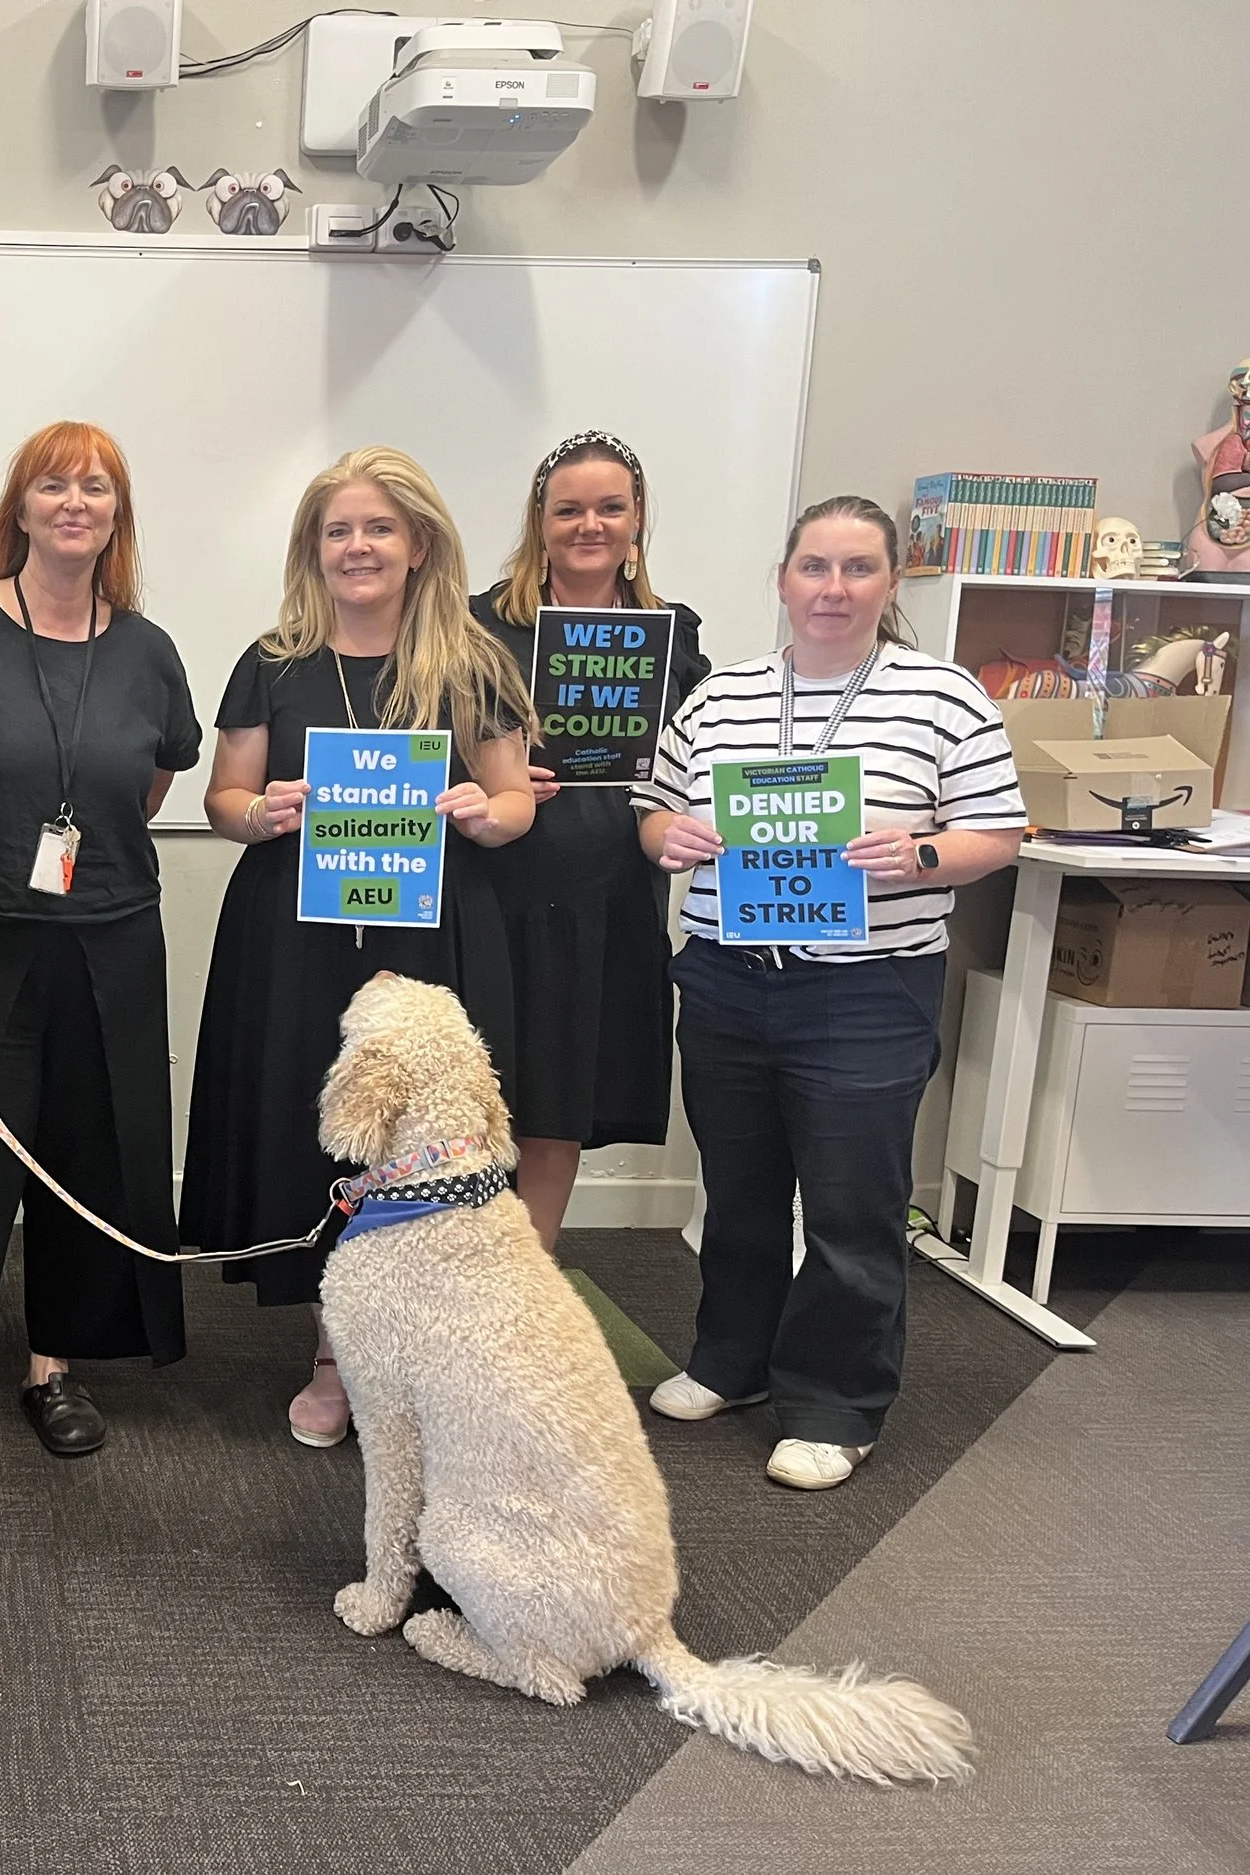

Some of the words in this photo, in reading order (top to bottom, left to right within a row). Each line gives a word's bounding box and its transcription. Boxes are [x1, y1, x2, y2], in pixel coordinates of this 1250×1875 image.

[495, 81, 525, 89] EPSON
[563, 623, 646, 649] WE’D
[549, 653, 655, 679] STRIKE
[557, 683, 584, 707] IF
[591, 685, 640, 709] WE
[543, 713, 649, 737] COULD
[420, 741, 441, 751] IEU
[575, 747, 608, 756] Catholic
[352, 750, 397, 771] We
[562, 755, 602, 765] education
[603, 752, 622, 761] staff
[744, 767, 785, 776] VICTORIAN
[786, 765, 824, 774] CATHOLIC
[752, 776, 795, 785] EDUCATION
[796, 774, 819, 782] STAFF
[317, 783, 397, 805] stand
[402, 782, 428, 806] in
[729, 790, 846, 816] DENIED
[315, 818, 432, 842] solidarity
[750, 820, 819, 844] OUR
[316, 848, 375, 873] with
[381, 852, 427, 874] the
[741, 848, 838, 870] RIGHT
[347, 888, 393, 905] AEU
[768, 876, 812, 896] TO
[738, 902, 847, 923] STRIKE
